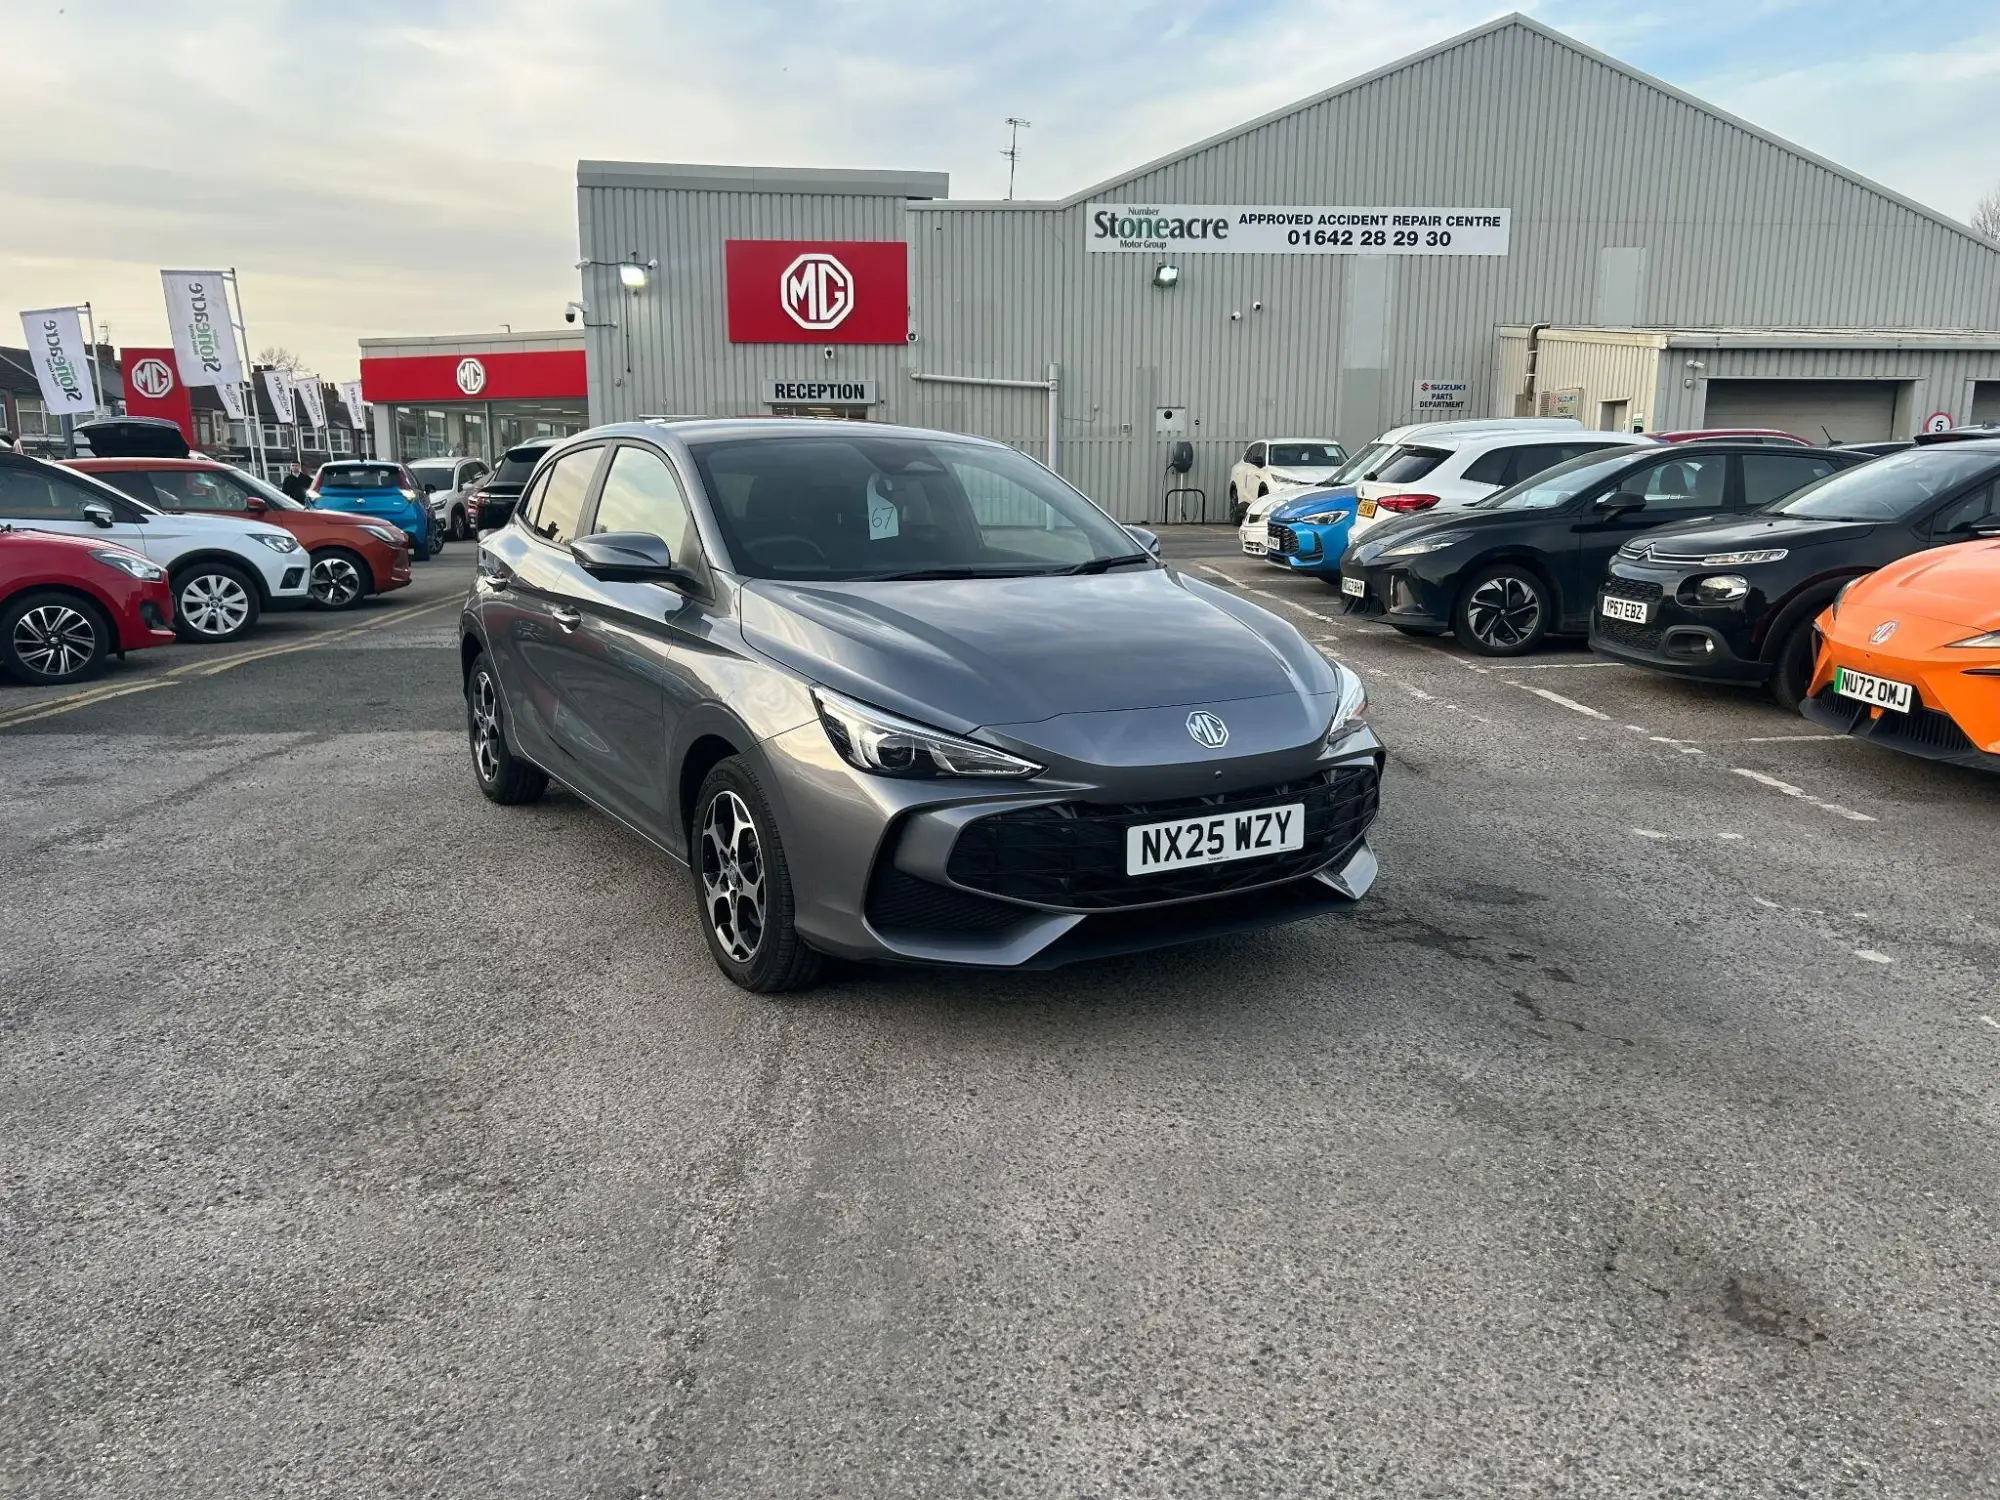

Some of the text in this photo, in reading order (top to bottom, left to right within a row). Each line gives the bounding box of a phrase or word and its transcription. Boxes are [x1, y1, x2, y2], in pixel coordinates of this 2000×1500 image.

[1128, 207, 1160, 216] Number
[1239, 213, 1501, 227] APPROVED ACCIDENT REPAIR CENTRE
[1094, 210, 1229, 240] Stoneacre
[1120, 240, 1167, 250] Motor Group
[1287, 229, 1451, 247] 01642 28 29 30
[787, 260, 848, 323] MG
[135, 361, 170, 395] MG
[459, 361, 482, 391] MG
[775, 383, 865, 399] RECEPTION
[1935, 420, 1944, 432] 5
[872, 507, 894, 530] 67
[1624, 602, 1643, 620] EBZ
[1841, 671, 1908, 707] NU72 OMJ
[1189, 714, 1226, 744] MG
[1142, 810, 1292, 866] NX25 WZY
